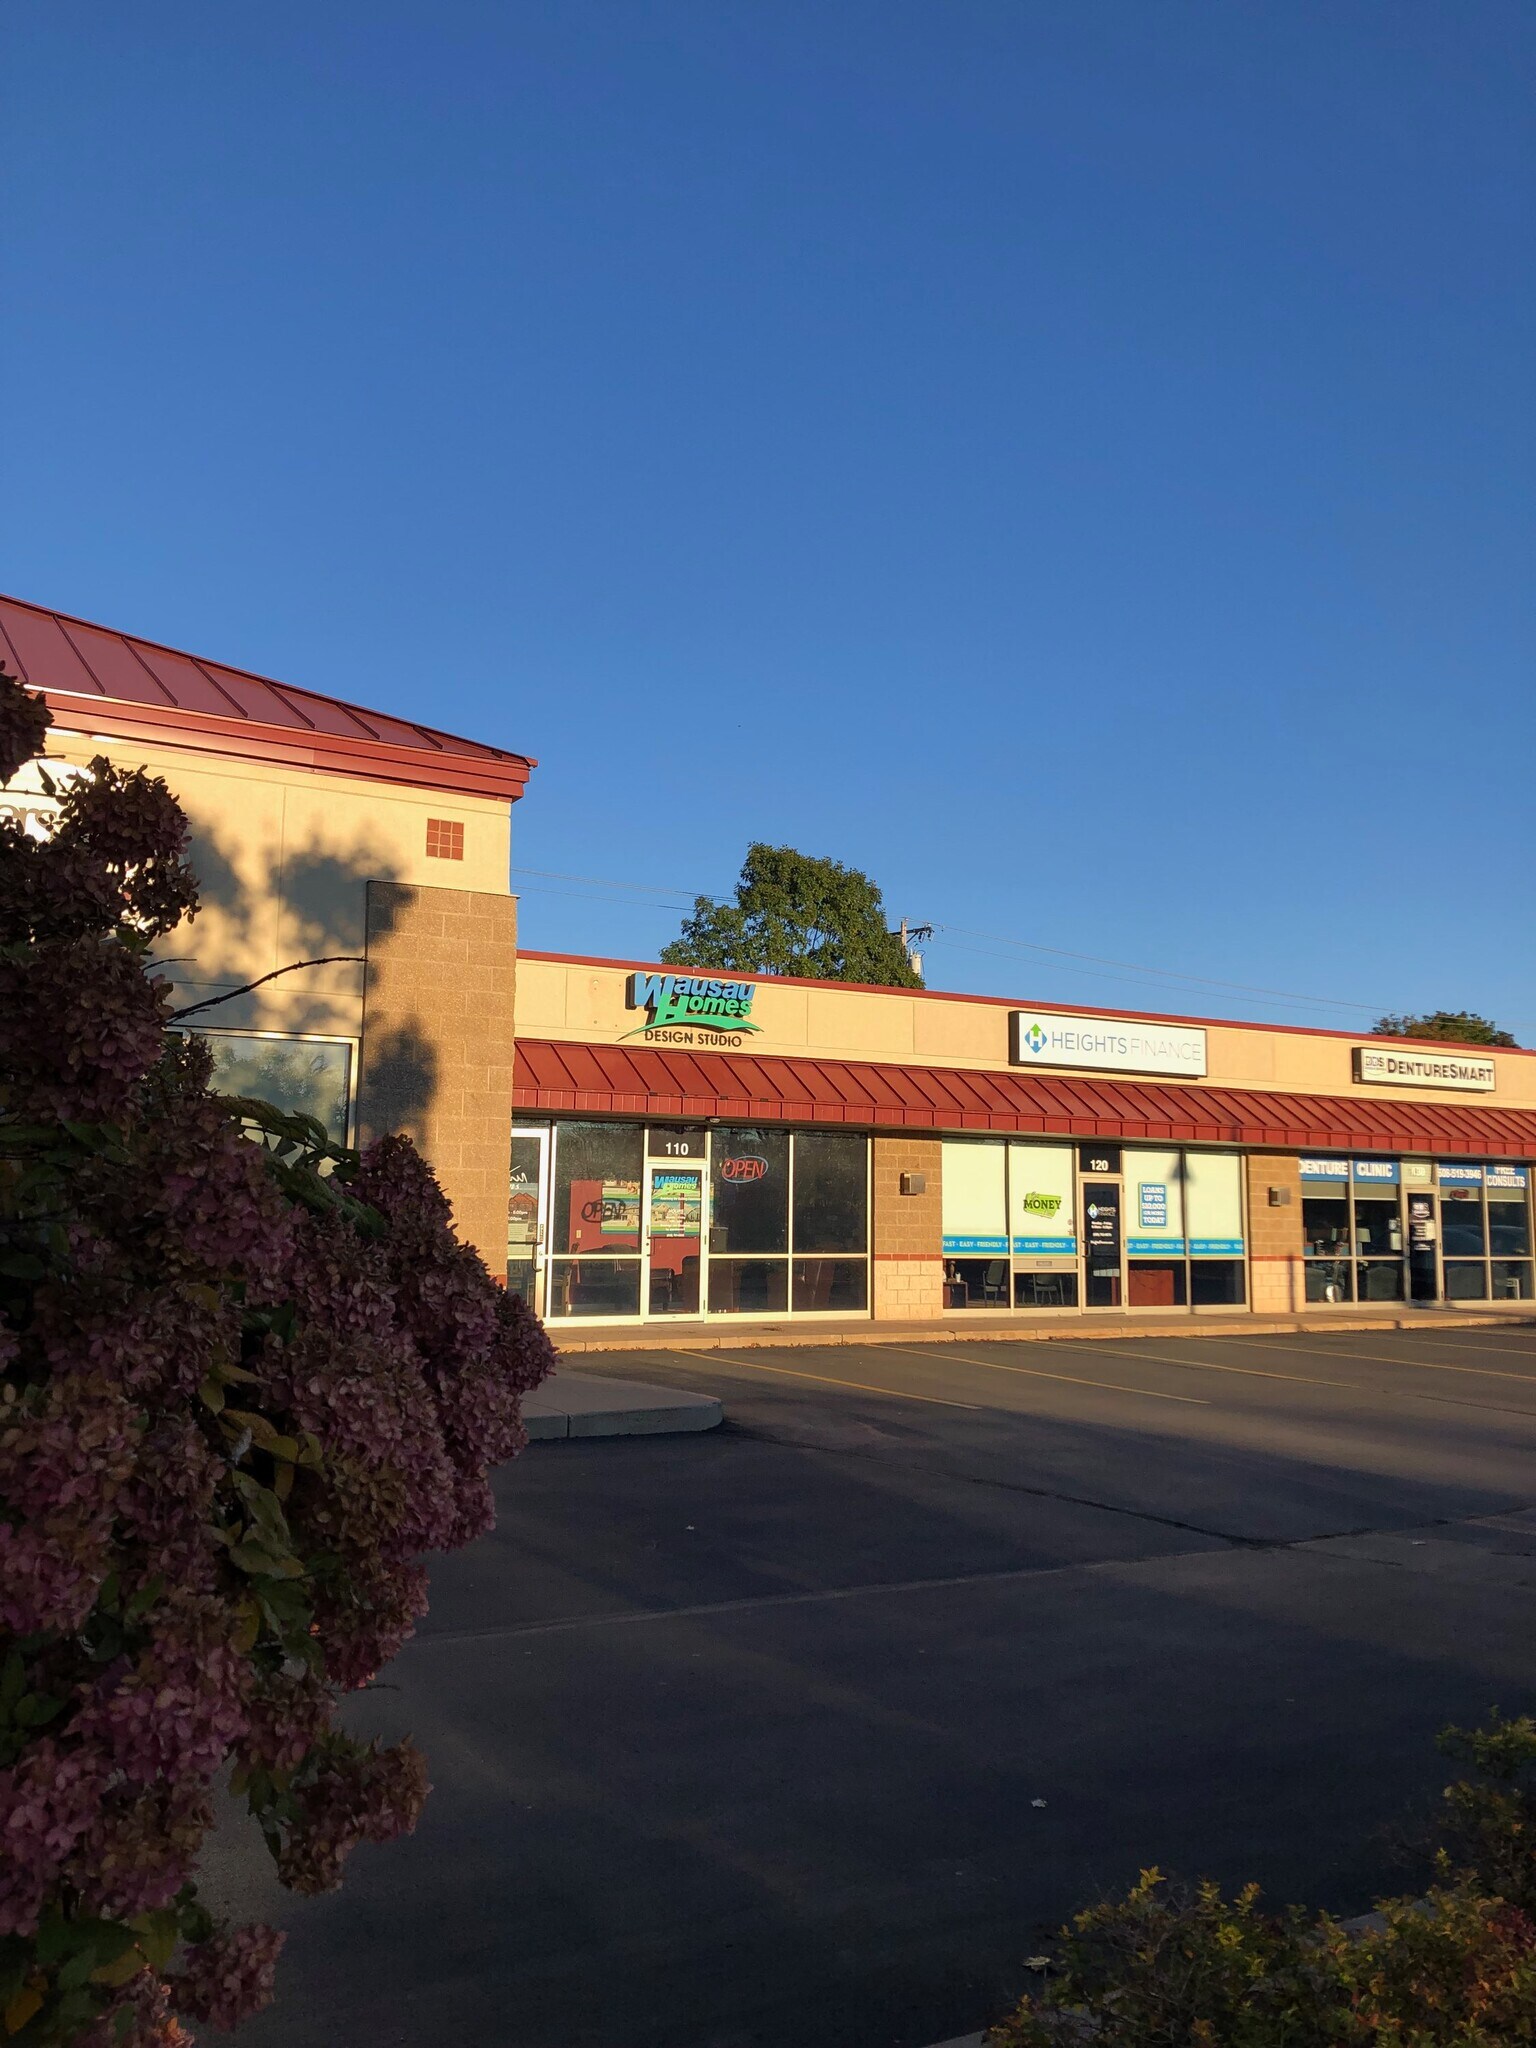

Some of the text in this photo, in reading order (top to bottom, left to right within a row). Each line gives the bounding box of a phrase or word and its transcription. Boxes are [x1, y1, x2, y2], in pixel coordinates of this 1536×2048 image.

[634, 972, 756, 1007] Wausau
[654, 992, 752, 1022] Homes
[644, 1029, 742, 1047] DESIGN STUDIO
[1051, 1031, 1202, 1061] HEIGHTS FINANCE
[665, 1142, 689, 1155] 110
[721, 1158, 764, 1179] OPEN
[1090, 1160, 1109, 1171] 120
[1356, 1163, 1393, 1177] CLINIC
[654, 1175, 698, 1189] Wausau
[1487, 1175, 1526, 1187] CONSULTS
[1023, 1199, 1062, 1210] MONEY
